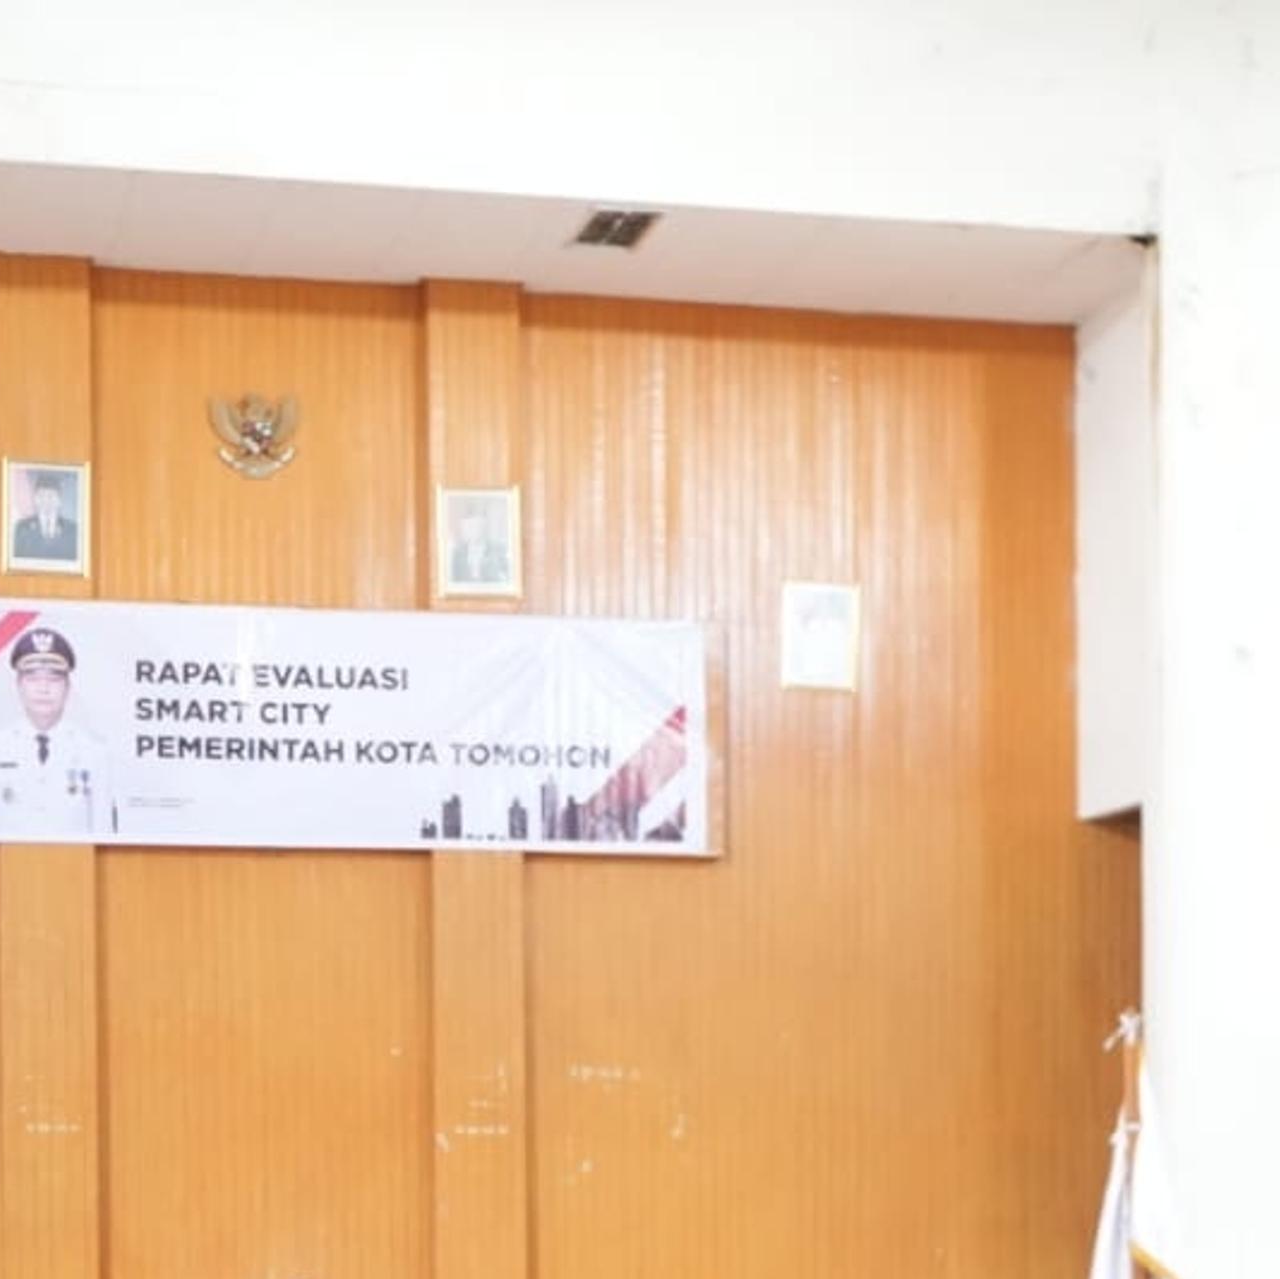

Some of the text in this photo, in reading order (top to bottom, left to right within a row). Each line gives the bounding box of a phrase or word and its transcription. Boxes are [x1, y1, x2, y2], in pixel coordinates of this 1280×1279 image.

[135, 660, 409, 690] RAPAT EVALUASI
[135, 698, 332, 725] SMART CITY
[135, 735, 611, 769] PEMERINTAH KOTA TOMOHON
